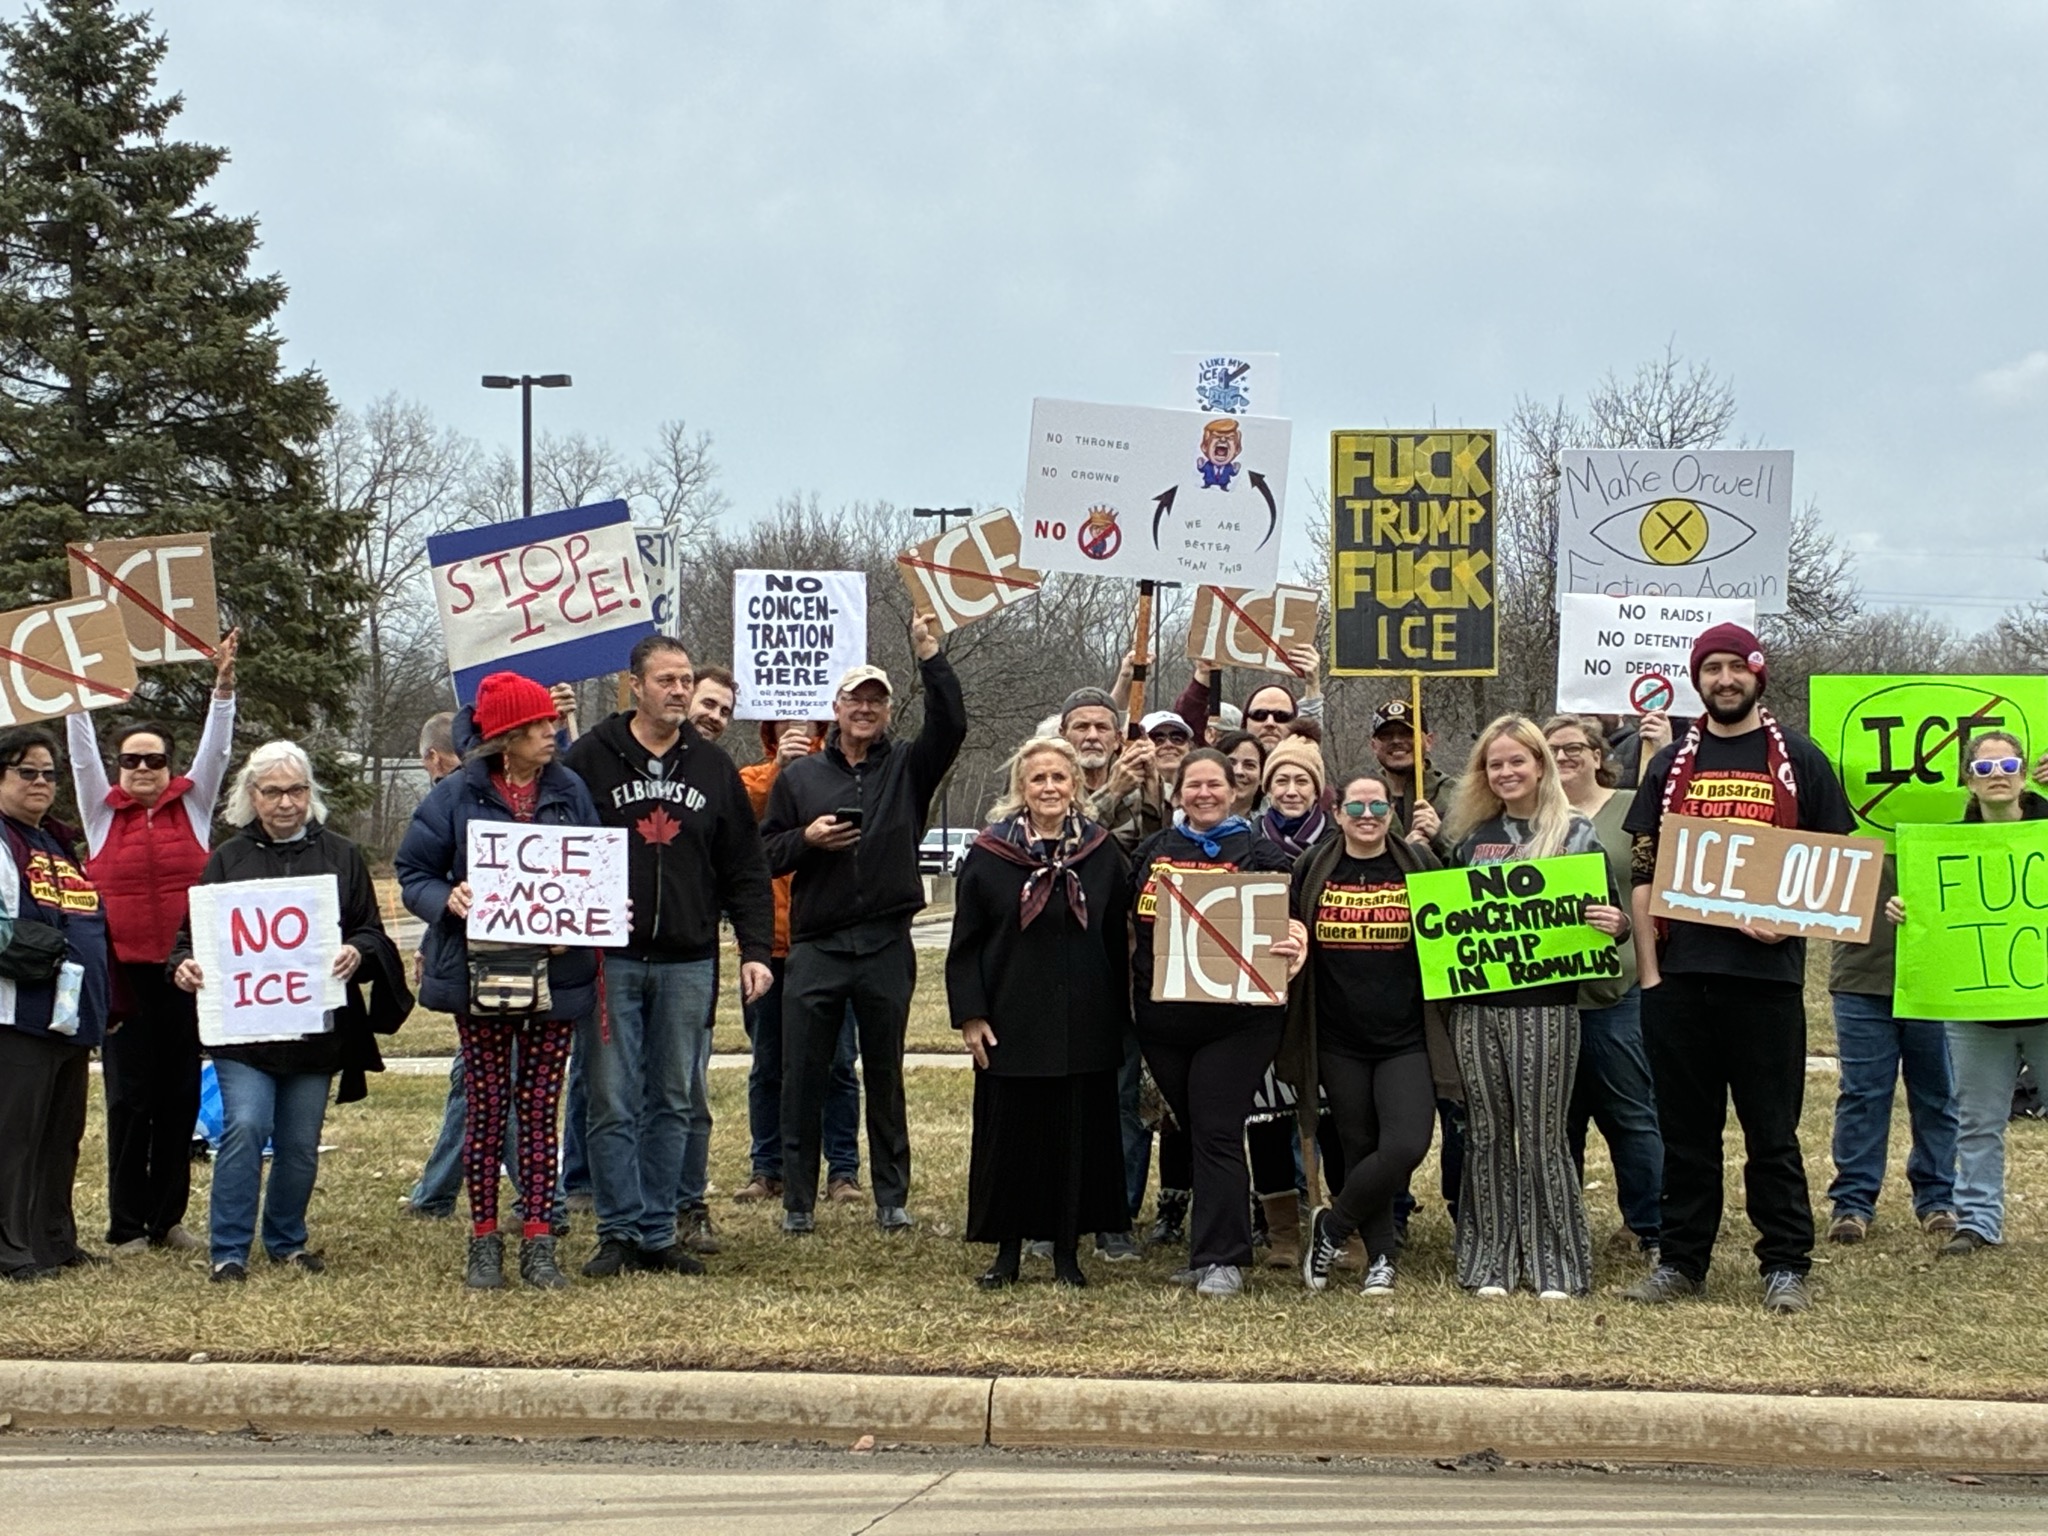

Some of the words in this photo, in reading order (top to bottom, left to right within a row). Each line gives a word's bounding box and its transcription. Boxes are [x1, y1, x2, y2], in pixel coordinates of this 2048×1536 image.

[1205, 358, 1225, 368] LIKE
[1228, 358, 1243, 368] MY
[1199, 368, 1218, 384] ICE
[1046, 432, 1063, 444] NO
[1075, 436, 1130, 451] THRONES
[1041, 467, 1058, 478] NO
[1071, 470, 1120, 483] CROWNS
[1337, 435, 1492, 497] FUCK
[1566, 454, 1661, 519] Make
[1673, 454, 1774, 503] Orwell
[1035, 519, 1066, 541] NO
[1184, 520, 1202, 530] WE
[1217, 521, 1241, 531] ARE
[1345, 499, 1486, 546] TRUMP
[636, 525, 679, 570] RTY
[1184, 540, 1231, 553] BETTER
[447, 535, 590, 614] STOP
[1177, 557, 1207, 571] THAN
[1219, 562, 1242, 574] THIS
[765, 574, 823, 593] NO
[1338, 549, 1493, 611] FUCK
[1696, 566, 1777, 598] Again
[507, 557, 641, 643] ICE!
[748, 596, 839, 620] CONCEN-
[1618, 604, 1646, 620] NO
[1660, 608, 1713, 624] RAIDS!
[747, 624, 834, 649] TRATION
[1378, 614, 1457, 660] ICE
[1598, 630, 1625, 647] NO
[1634, 633, 1697, 649] DETENTI
[754, 651, 829, 667] CAMP
[1584, 659, 1611, 675] NO
[1626, 661, 1690, 677] DEPORTA
[755, 668, 829, 686] HERE
[685, 786, 707, 812] UP
[1708, 784, 1773, 800] pasarán
[1701, 802, 1734, 817] OUT
[1735, 802, 1775, 821] NOW
[474, 833, 595, 876] ICE
[1467, 864, 1546, 901] NO
[1672, 828, 1755, 899] ICE
[1777, 843, 1873, 912] OUT
[1937, 852, 2048, 912] FUC
[510, 881, 565, 903] NO
[486, 907, 613, 937] MORE
[1319, 907, 1337, 920] ICE
[1340, 907, 1372, 921] OUT
[1373, 908, 1409, 921] NOW
[229, 906, 309, 956] NO
[1317, 924, 1356, 939] Fuera
[1359, 925, 1409, 940] Trump
[1457, 933, 1542, 966] CAMP
[1947, 923, 2048, 992] IC
[1447, 963, 1490, 995] IN
[1507, 945, 1621, 985] ROMULUS
[233, 971, 312, 1008] ICE
